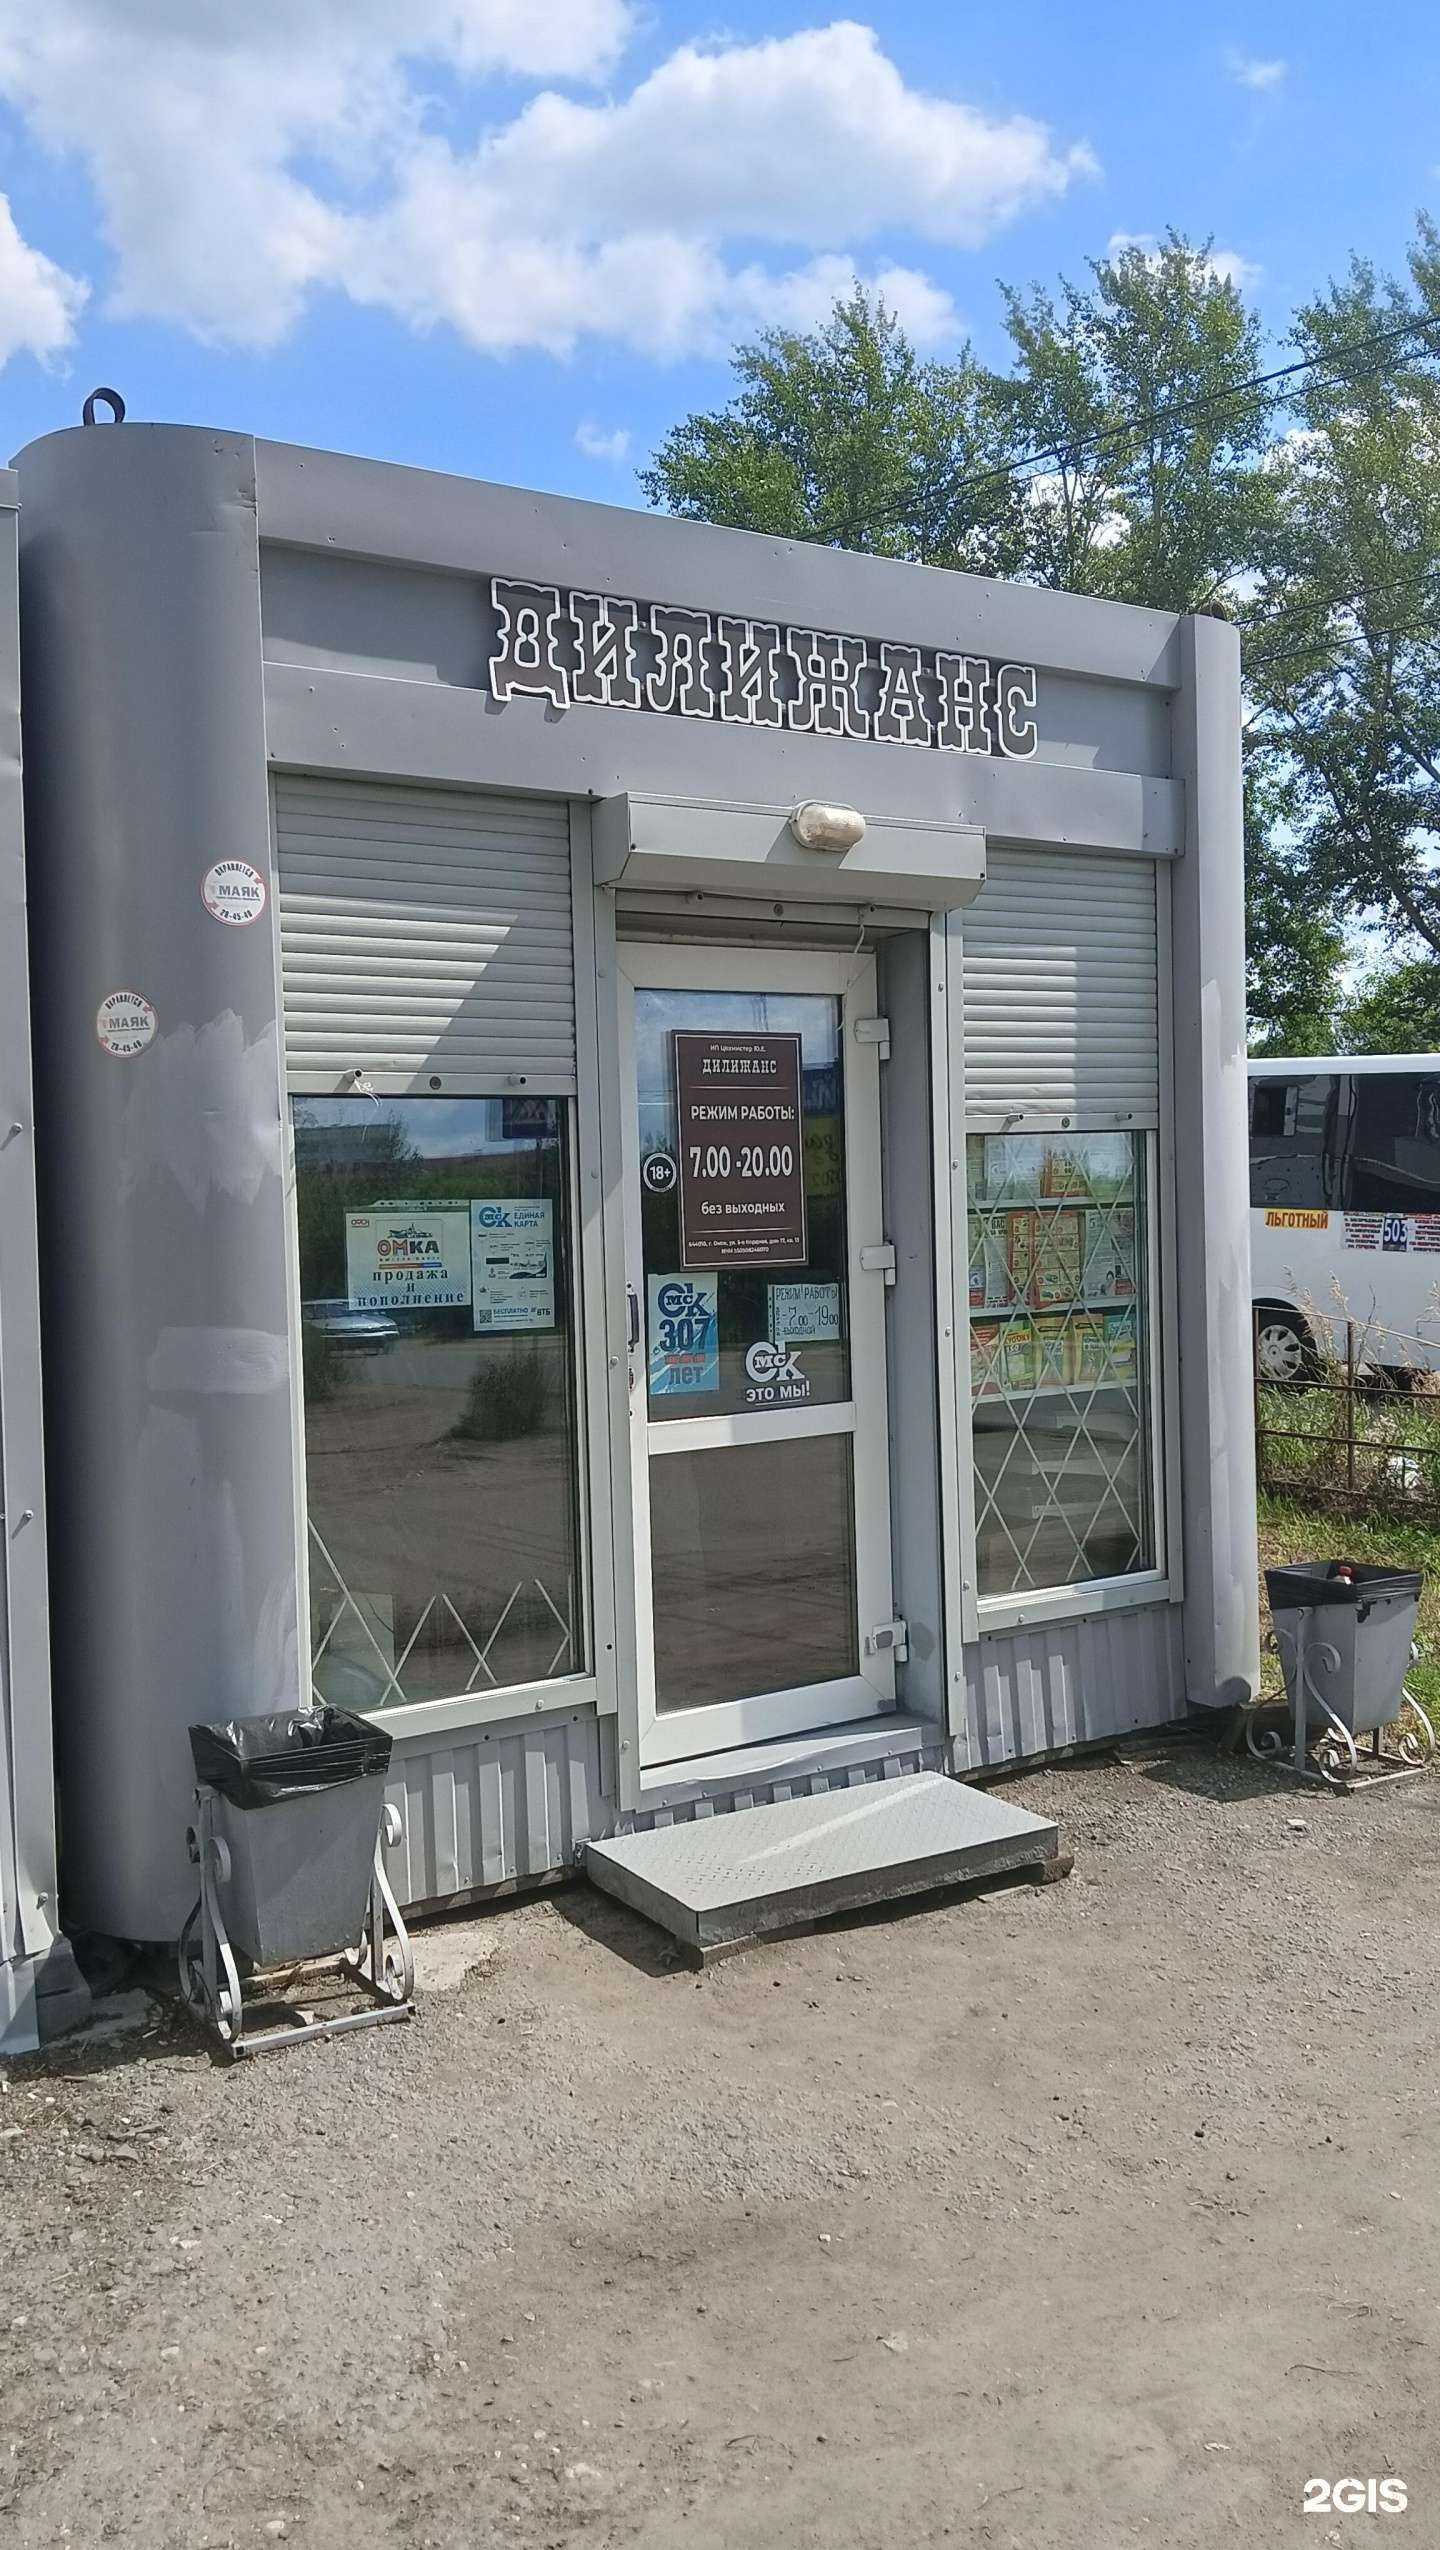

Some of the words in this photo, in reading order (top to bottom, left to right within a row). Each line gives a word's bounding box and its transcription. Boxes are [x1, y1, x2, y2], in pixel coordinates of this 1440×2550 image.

[489, 577, 1038, 760] ДИЛИЖАНС
[218, 884, 260, 898] МАЯК
[109, 1015, 150, 1029] МАЯК
[702, 1058, 777, 1075] ДИЛИЖАНС
[690, 1105, 738, 1121] РЕЖИМ
[741, 1105, 795, 1121] РАБОТЫ:
[689, 1146, 731, 1179] 7.00
[649, 1165, 671, 1181] 18+
[513, 1211, 545, 1221] ЕДИНАЯ
[701, 1201, 723, 1216] без
[725, 1201, 785, 1216] выходных
[513, 1220, 539, 1229] КАРТА
[1265, 1210, 1329, 1230] ЛЬГОТНЫЙ
[1383, 1219, 1409, 1243] 503
[376, 1239, 440, 1257] ОМКА
[372, 1268, 449, 1285] продажа
[406, 1283, 416, 1292] и
[357, 1292, 464, 1307] пополнение
[659, 1318, 710, 1352] 307
[668, 1366, 704, 1386] лет
